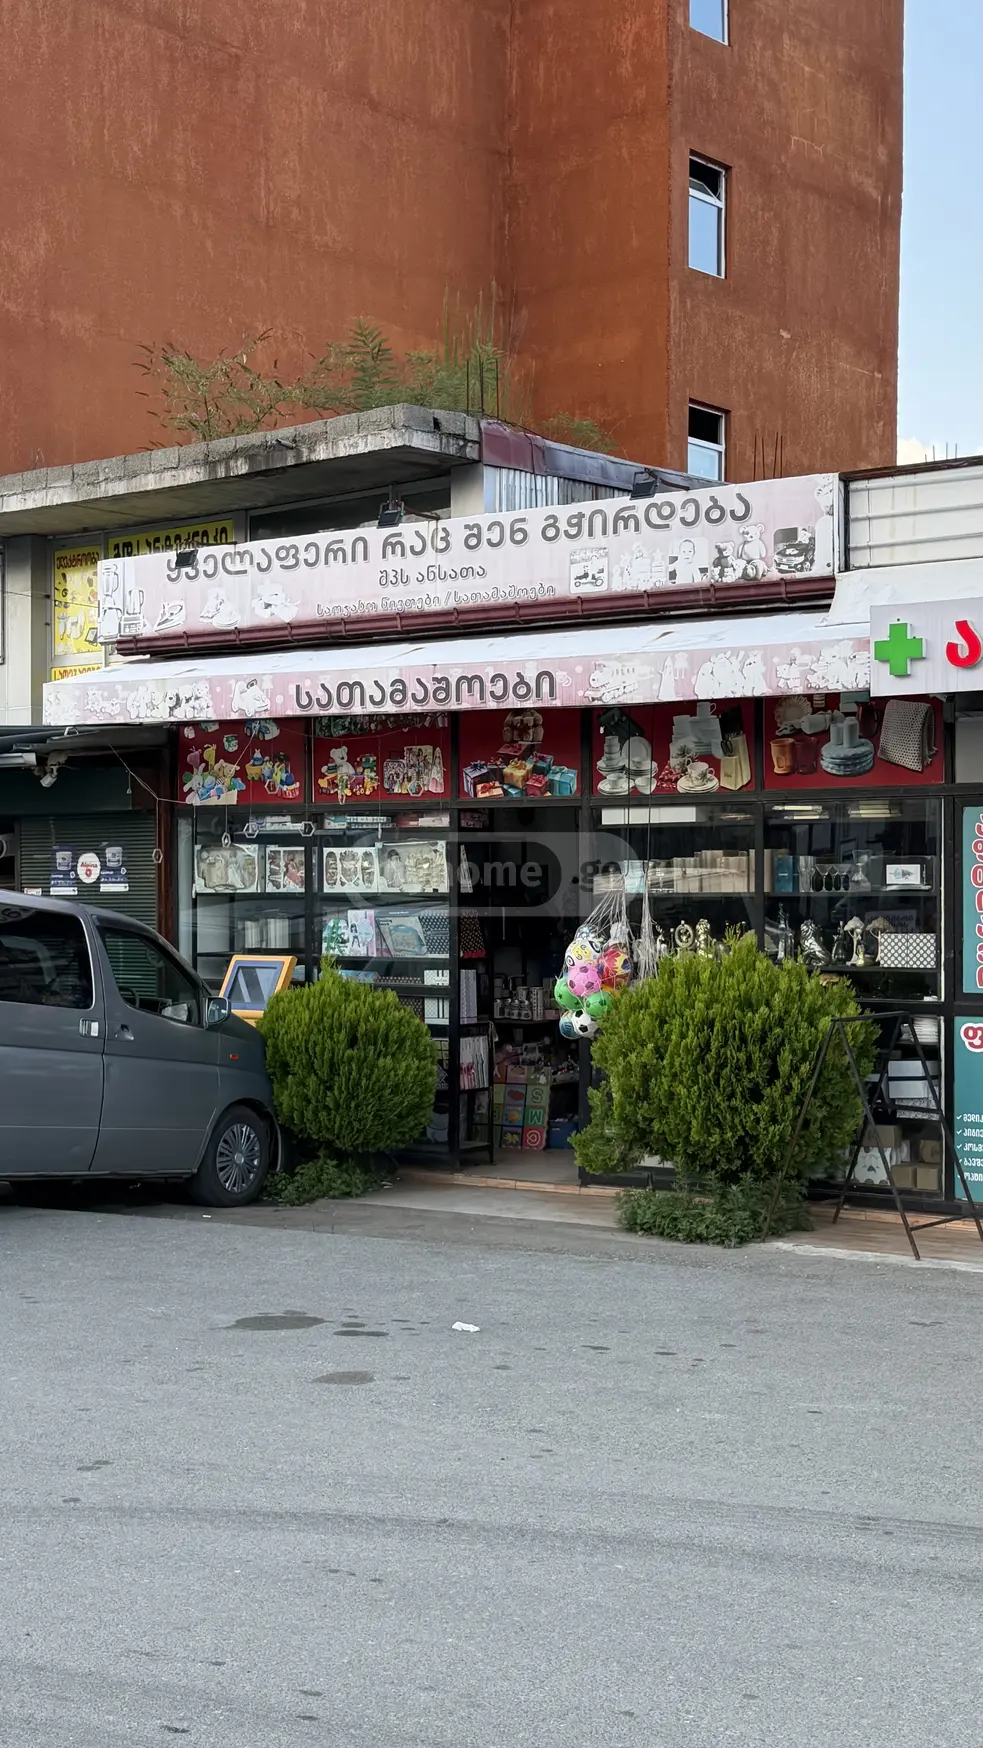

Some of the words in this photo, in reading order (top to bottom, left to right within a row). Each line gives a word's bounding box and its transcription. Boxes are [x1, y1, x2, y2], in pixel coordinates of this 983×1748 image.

[167, 535, 369, 582] ყველაფერი
[382, 526, 451, 559] რაც
[463, 517, 528, 550] შენ
[541, 493, 751, 542] გჭირდება
[378, 568, 409, 587] შპს
[416, 564, 486, 584] ანსათა
[381, 594, 440, 612] ნივთები
[295, 670, 556, 709] სათამაშოები
